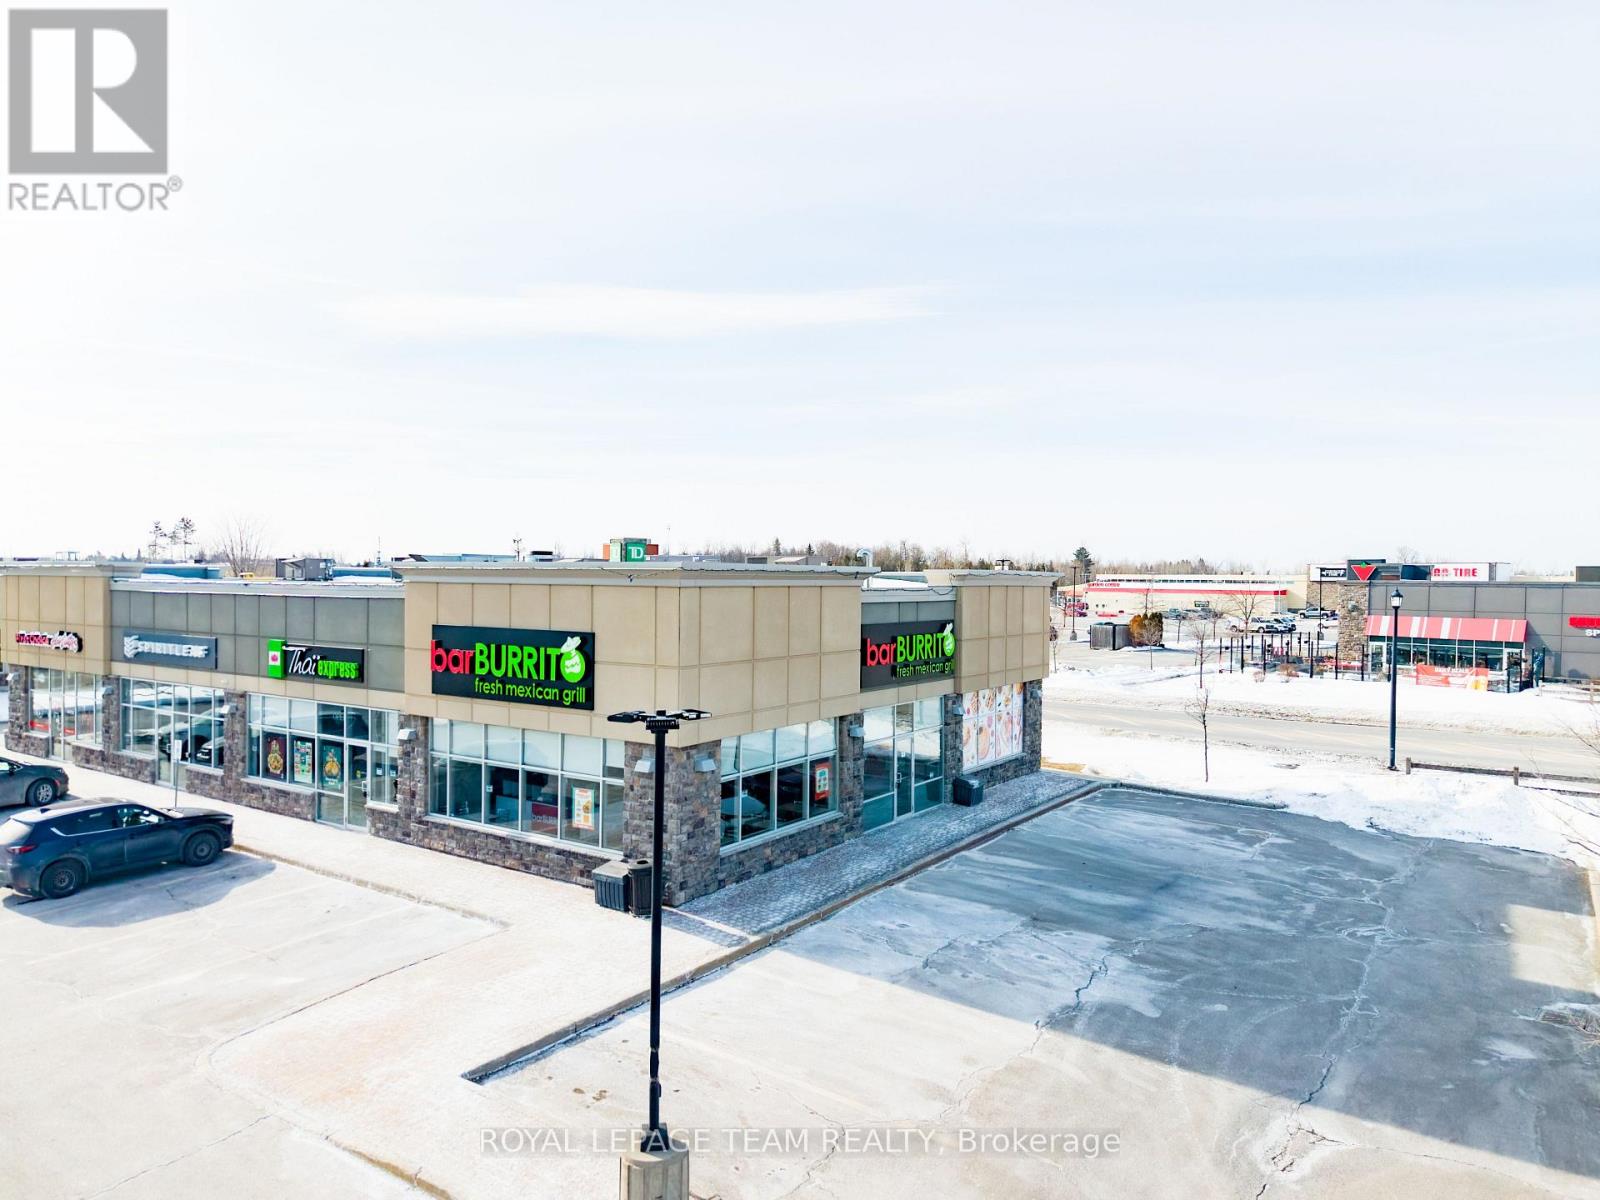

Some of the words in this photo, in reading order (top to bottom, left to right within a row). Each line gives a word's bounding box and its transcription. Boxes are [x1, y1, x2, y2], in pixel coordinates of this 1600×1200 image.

[628, 546, 644, 559] TD
[1431, 568, 1449, 577] AN
[1453, 567, 1478, 577] TIRE
[317, 660, 359, 679] express
[896, 664, 913, 678] fresh
[915, 661, 944, 674] mexican
[475, 677, 503, 695] fresh
[506, 683, 559, 701] mexican
[563, 687, 586, 705] grill
